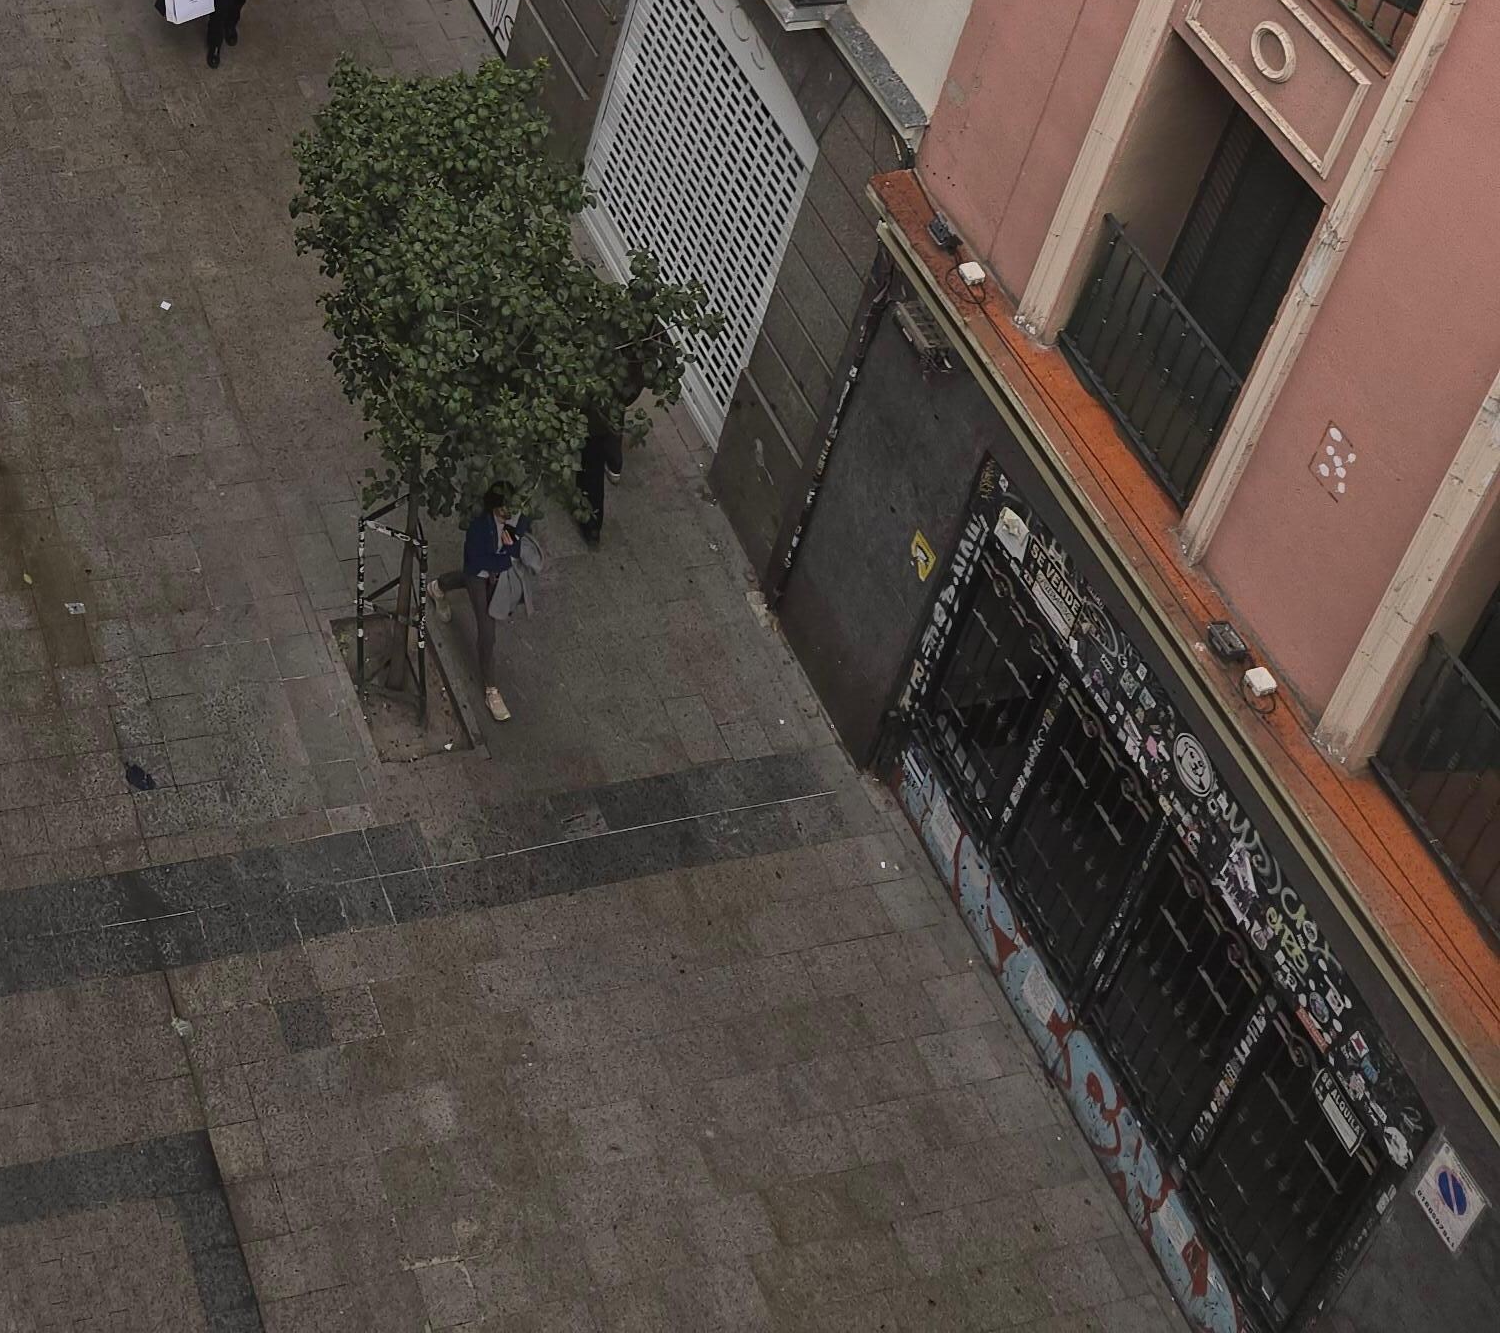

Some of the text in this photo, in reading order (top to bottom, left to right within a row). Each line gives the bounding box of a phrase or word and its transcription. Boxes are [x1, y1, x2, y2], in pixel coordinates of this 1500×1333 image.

[1030, 543, 1045, 567] SE
[1045, 563, 1083, 616] VENDE
[1320, 1071, 1361, 1136] SE ALQUILA
